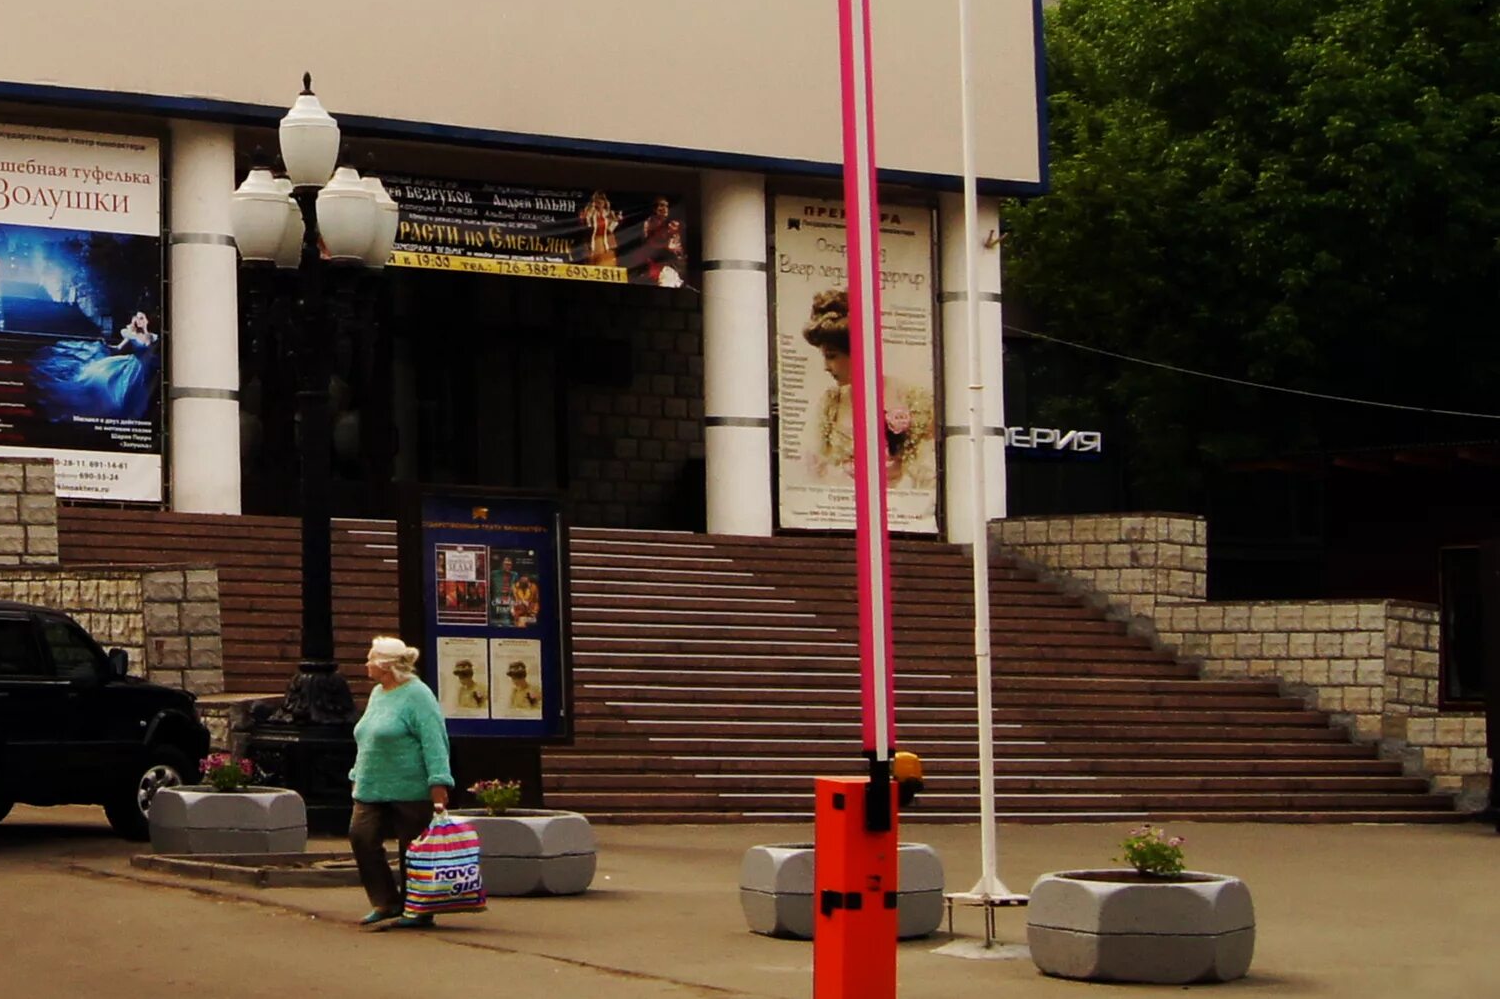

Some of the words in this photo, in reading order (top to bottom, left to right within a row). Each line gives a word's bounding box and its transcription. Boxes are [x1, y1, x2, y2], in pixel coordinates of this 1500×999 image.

[72, 166, 151, 185] туфелька
[400, 221, 459, 244] РАСТИ
[464, 230, 485, 247] по
[417, 256, 449, 268] 19:00
[566, 266, 622, 282] 690-2811
[1004, 426, 1101, 452] ЕРИЯ
[54, 459, 85, 467] 0-28-11
[56, 483, 109, 493] kinoaktera.ru
[434, 865, 478, 881] rave
[450, 876, 482, 897] girl
